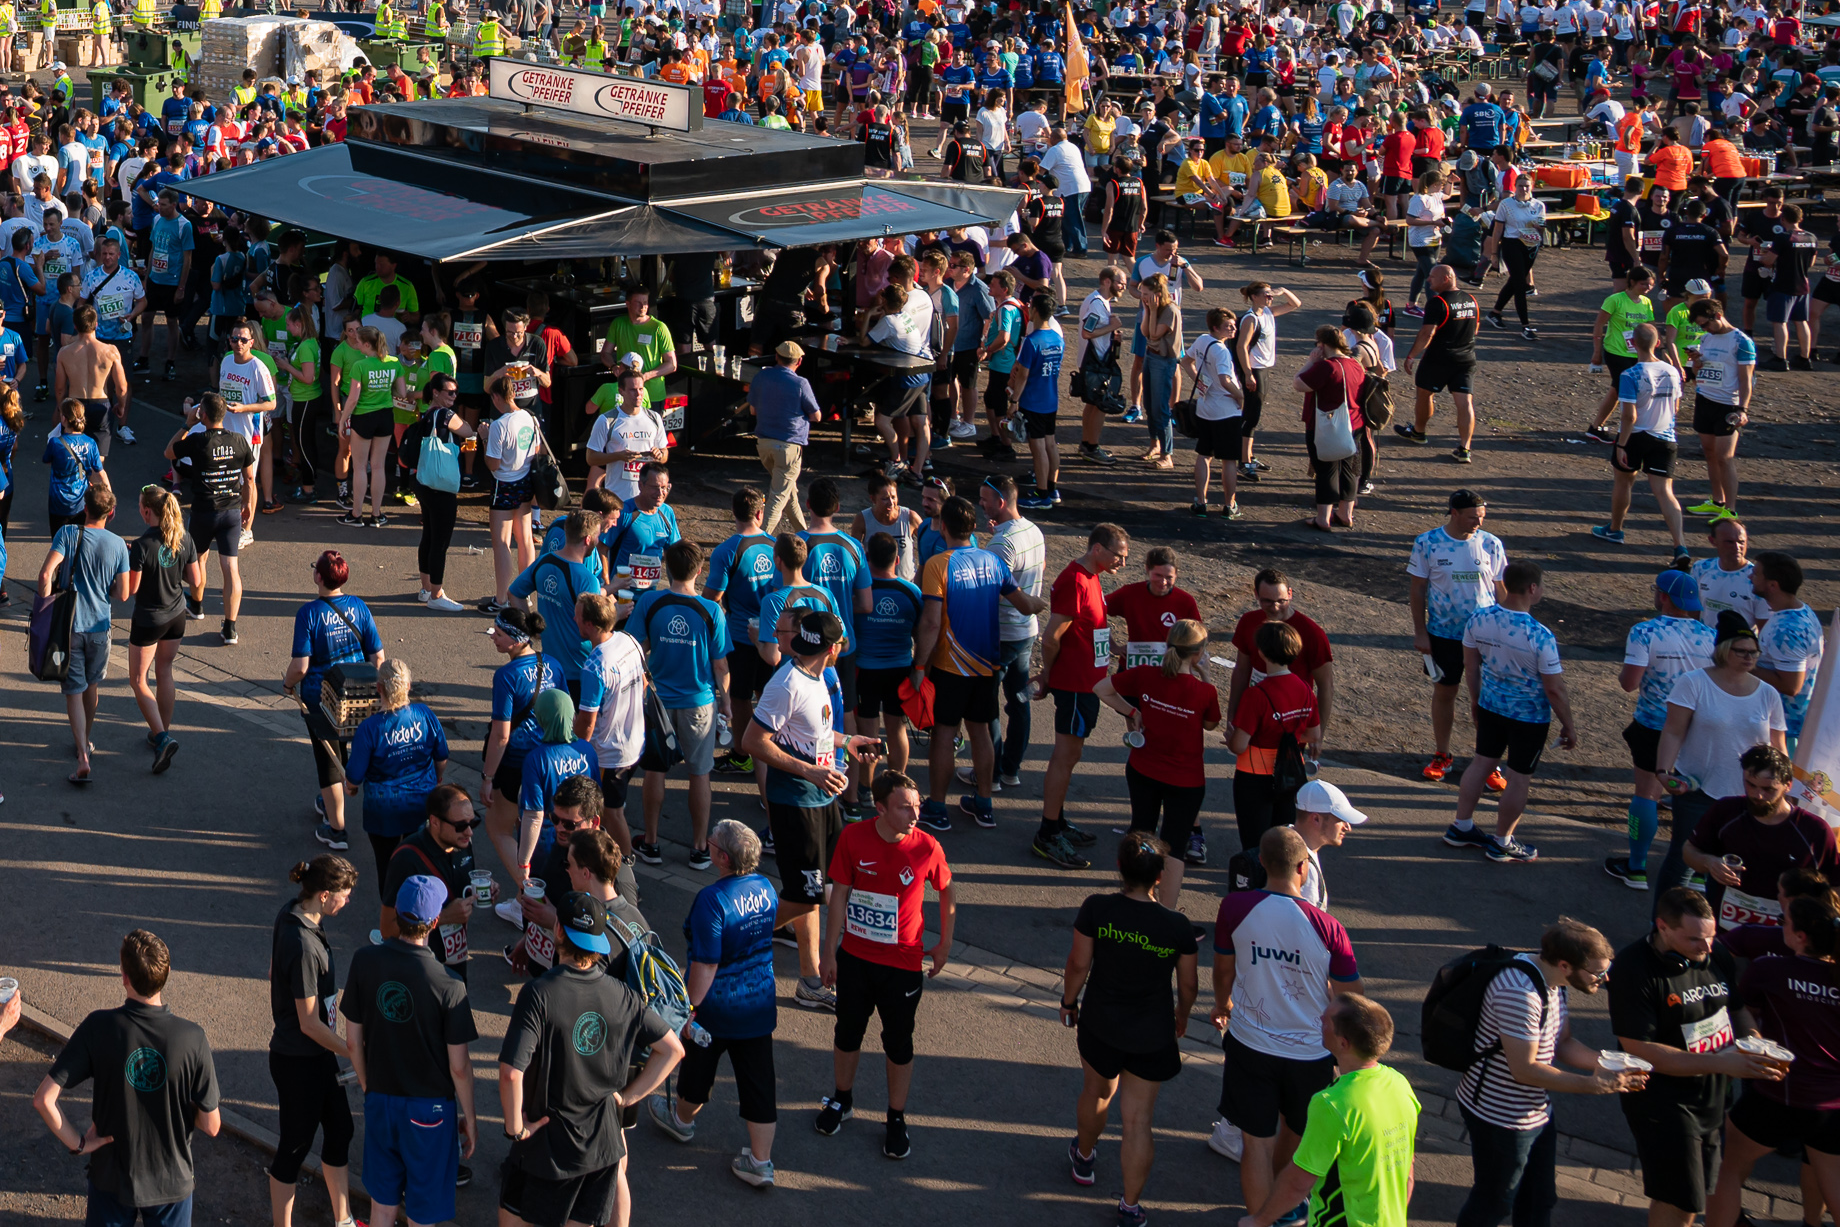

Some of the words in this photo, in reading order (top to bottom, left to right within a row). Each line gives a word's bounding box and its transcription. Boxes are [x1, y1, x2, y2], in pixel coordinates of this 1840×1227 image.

[177, 20, 201, 30] FINIS
[522, 71, 574, 90] GETRÄNKE
[532, 86, 571, 103] PFEIFER
[611, 85, 668, 106] GETRÄNKE
[621, 100, 665, 119] PFEIFER
[760, 193, 902, 219] GETRÄNKE
[100, 301, 123, 314] 1610
[455, 331, 481, 342] 7140
[226, 372, 251, 386] BOSCH
[618, 431, 652, 440] VIACTIV
[660, 636, 697, 646] thyssenkrupp
[385, 721, 422, 746] Victor's
[554, 754, 589, 775] Victor's
[734, 888, 771, 916] Victor's
[848, 905, 896, 930] 13634
[850, 923, 867, 935] REWE
[1098, 923, 1149, 946] physio
[1142, 942, 1176, 958] lounge
[1251, 941, 1301, 965] juwi
[1682, 981, 1728, 1005] ARCADIS
[1788, 978, 1840, 998] INDIC
